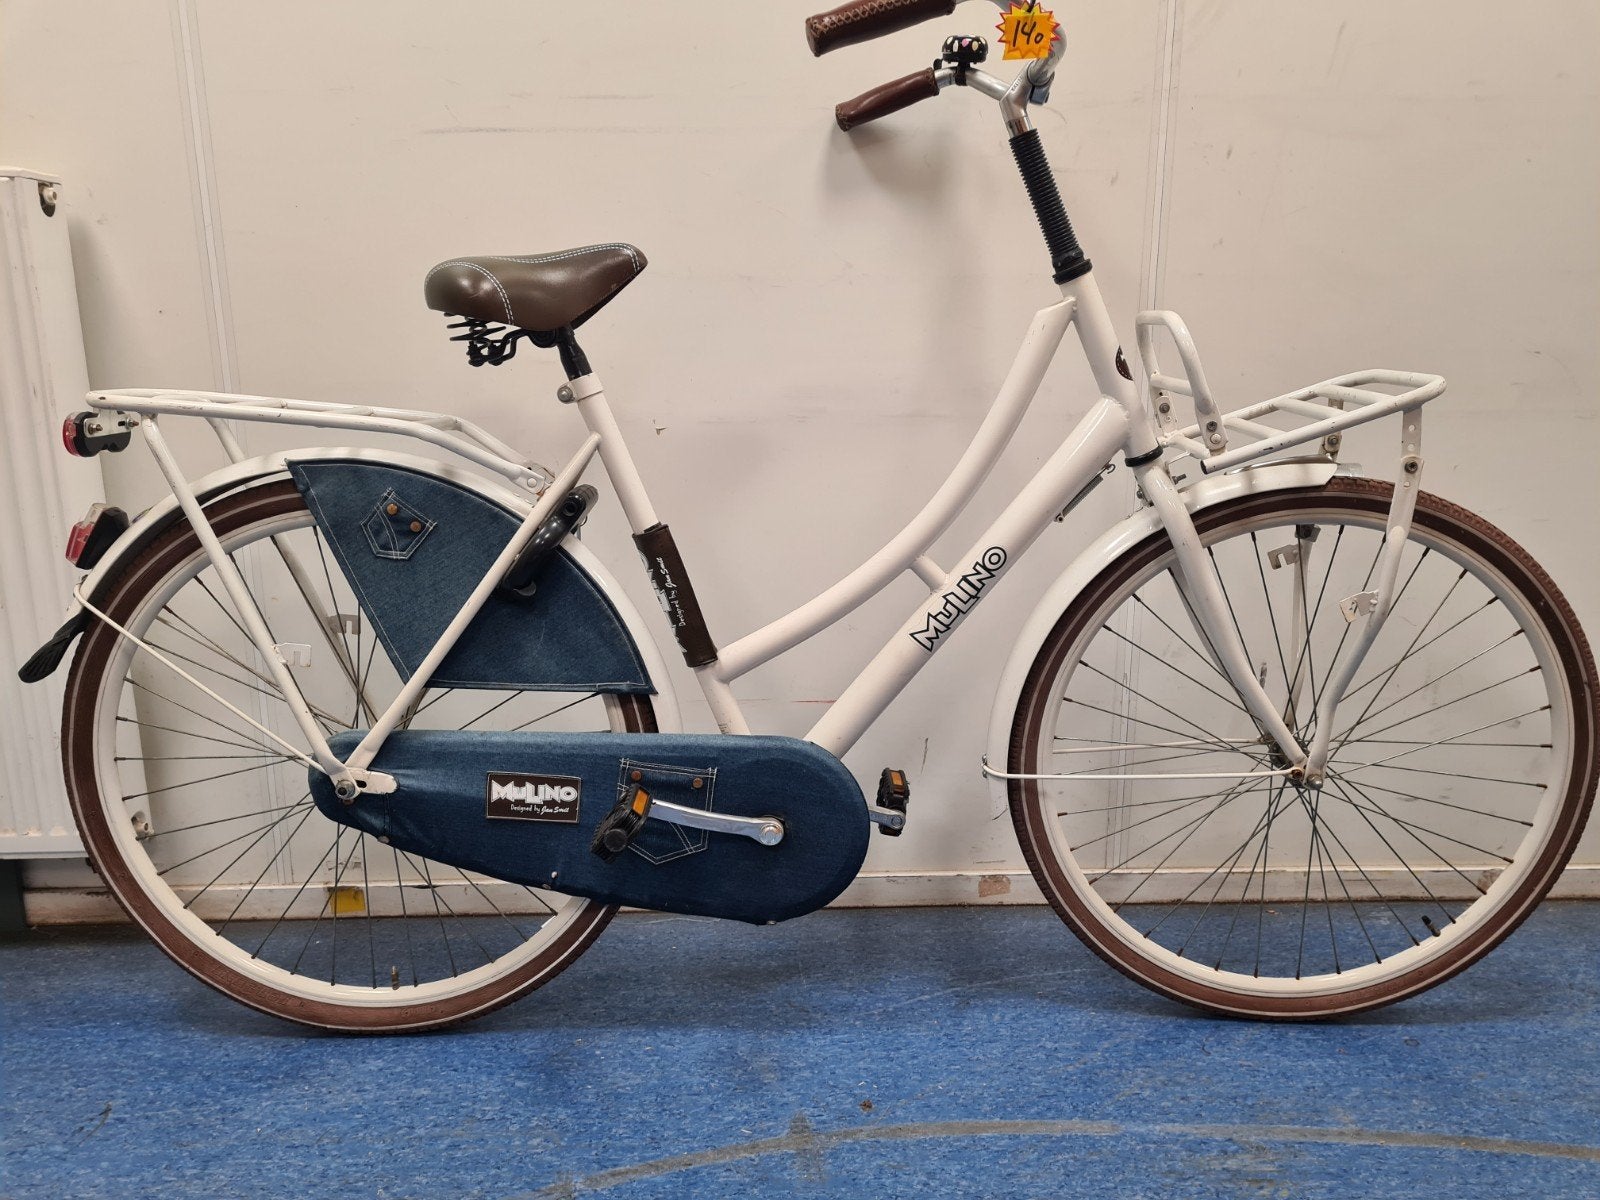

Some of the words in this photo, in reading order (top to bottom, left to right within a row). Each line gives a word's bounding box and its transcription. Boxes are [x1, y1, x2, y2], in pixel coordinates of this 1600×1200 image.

[1012, 19, 1044, 48] 140
[510, 803, 533, 813] Designed
[534, 805, 541, 813] by
